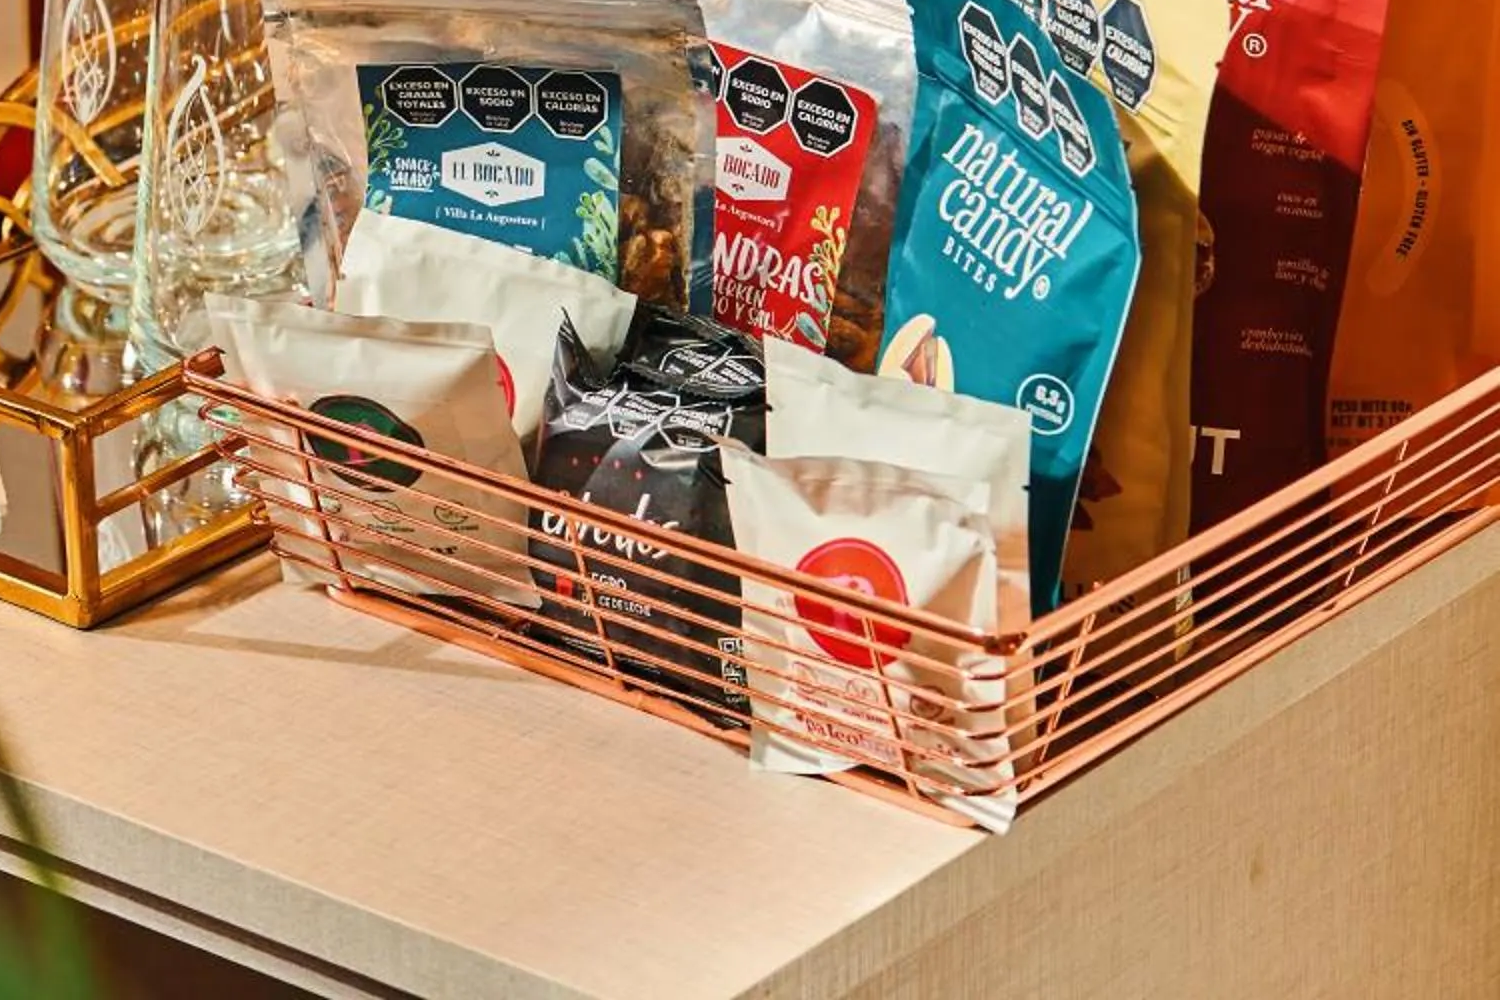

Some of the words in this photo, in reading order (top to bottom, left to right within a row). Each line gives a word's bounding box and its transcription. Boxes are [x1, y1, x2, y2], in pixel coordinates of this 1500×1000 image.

[389, 81, 432, 91] EXCESO
[433, 81, 449, 91] EN
[465, 87, 508, 98] EXCESO
[510, 89, 526, 99] EN
[732, 77, 769, 98] EXCESO
[769, 91, 785, 103] EN
[396, 100, 446, 109] TOTALES
[541, 91, 583, 102] EXCESO
[586, 93, 601, 103] EN
[740, 92, 772, 110] SODIO
[797, 99, 835, 119] EXCESO
[836, 111, 851, 124] EN
[394, 157, 431, 172] SNACK
[722, 153, 781, 189] BOCADO
[390, 170, 434, 187] SALADO
[453, 161, 468, 181] EL
[472, 162, 534, 187] BOCADO
[942, 123, 1094, 260] natural
[444, 207, 468, 218] Villa
[469, 209, 484, 219] La
[485, 210, 539, 226] Angostura
[942, 236, 997, 293] BITES
